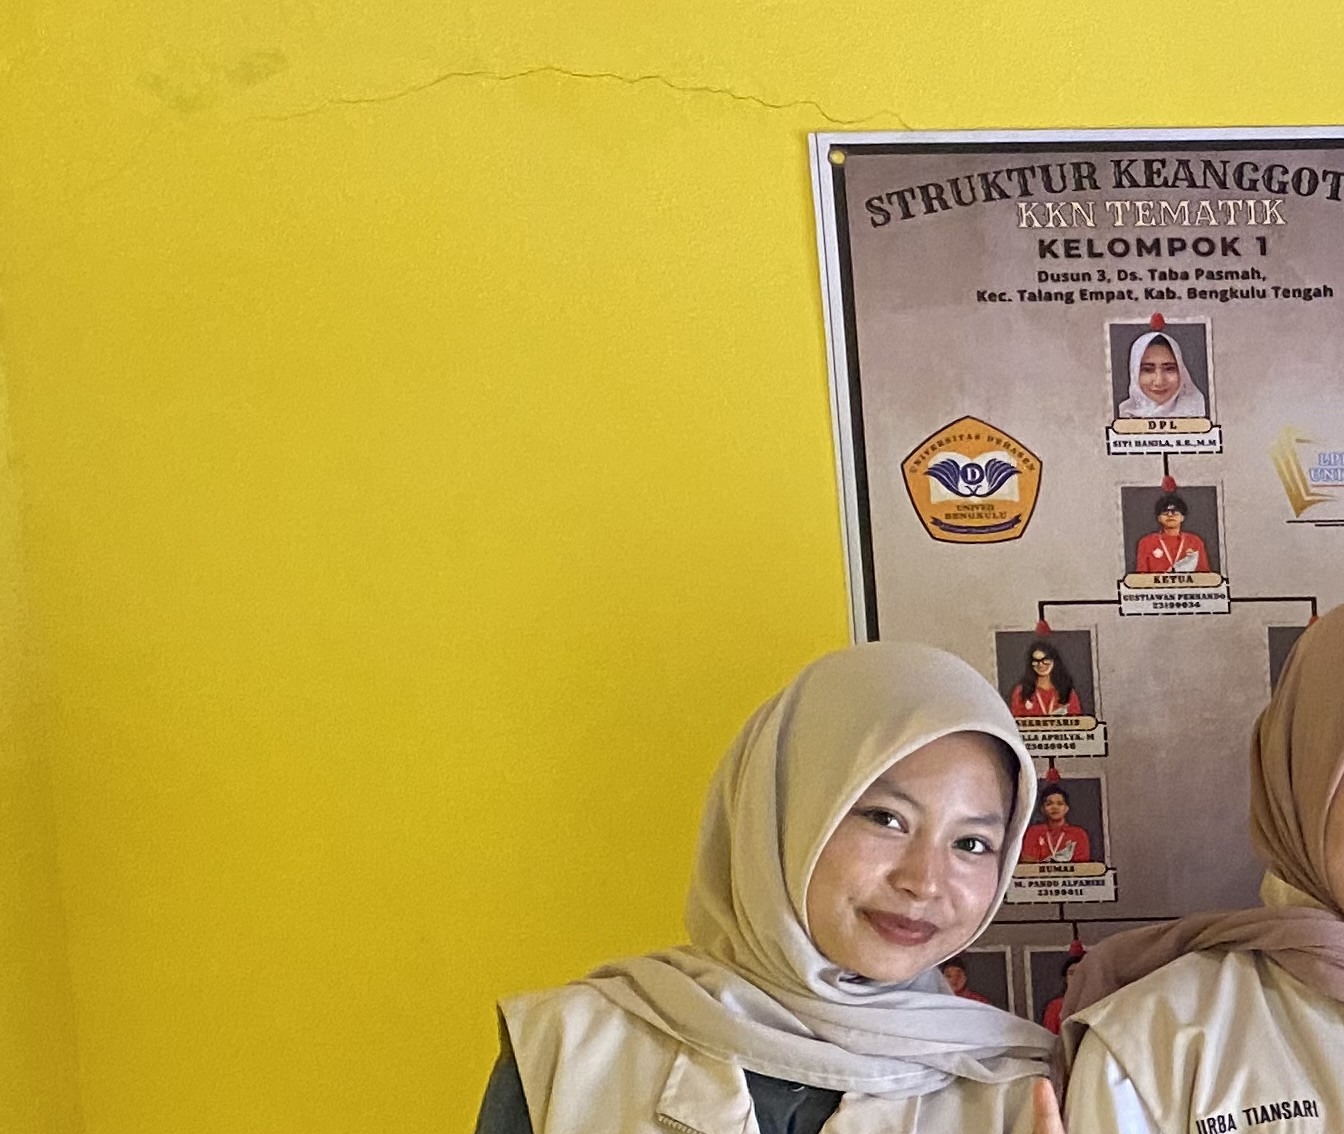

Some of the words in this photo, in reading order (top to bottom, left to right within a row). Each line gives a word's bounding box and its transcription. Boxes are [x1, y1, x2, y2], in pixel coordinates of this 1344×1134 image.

[864, 160, 1101, 229] STRUKTUR
[1016, 201, 1097, 229] KKN
[1105, 199, 1287, 228] TEMATIK
[1037, 236, 1242, 260] KELOMPOK
[1255, 235, 1268, 257] 1
[1037, 270, 1092, 284] Dusun
[1096, 269, 1111, 286] 3,
[1117, 270, 1143, 283] Ds.
[1149, 268, 1189, 282] Taba
[1195, 266, 1267, 283] Pasmah,
[976, 289, 1013, 303] Kec.
[1017, 288, 1075, 304] Talang
[1079, 288, 1139, 304] Empat,
[1144, 286, 1183, 301] Kab.
[1187, 286, 1267, 303] Bengkulu
[1271, 285, 1335, 302] Tengah
[966, 467, 979, 482] D
[1153, 574, 1194, 584] KETUA
[1241, 1099, 1320, 1127] TIANSARI
